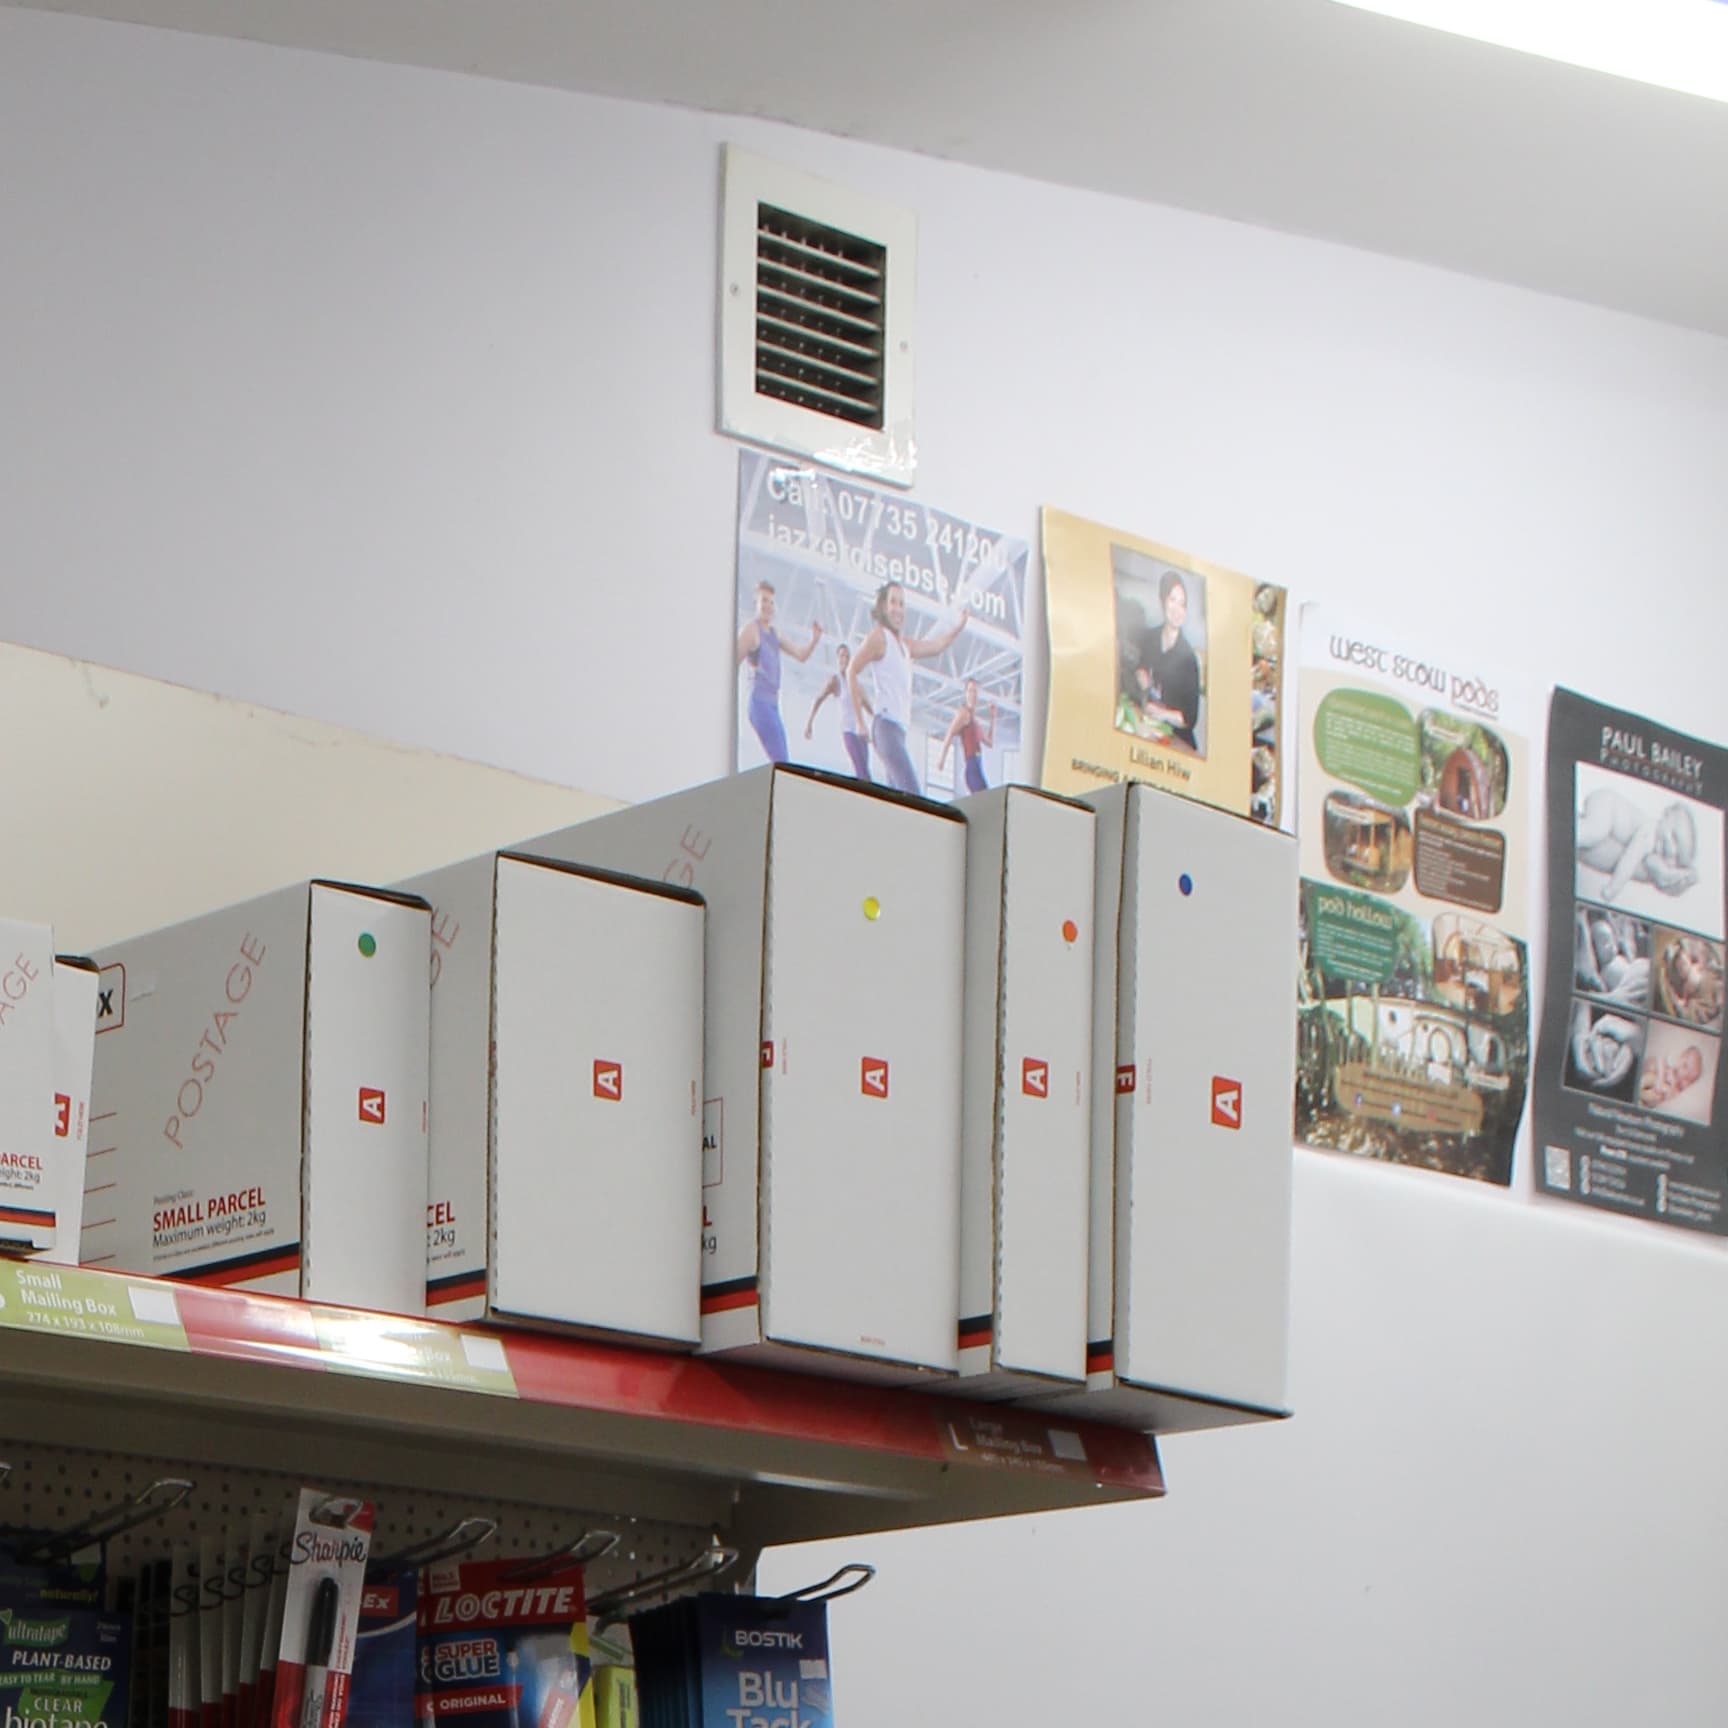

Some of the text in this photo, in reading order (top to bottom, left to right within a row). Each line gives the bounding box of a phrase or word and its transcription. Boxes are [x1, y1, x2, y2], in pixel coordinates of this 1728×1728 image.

[839, 491, 918, 541] 07735
[1129, 746, 1167, 774] Lilian
[1601, 726, 1646, 758] PAUL
[1651, 742, 1703, 779] BAILEY
[164, 931, 267, 1151] POSTAGE
[152, 1187, 266, 1232] SMALL PARCEL
[15, 1269, 63, 1293] Small
[20, 1287, 118, 1319] Mailing Box
[289, 1530, 367, 1568] Sharpie
[434, 1586, 574, 1625] LOCTITE
[435, 1639, 497, 1661] SUPER
[735, 1630, 803, 1649] BOSTIK
[12, 1650, 112, 1671] PLANT-BASED
[434, 1654, 500, 1682] GLUE
[440, 1692, 506, 1710] ORIGINAL
[739, 1670, 799, 1708] Blu
[34, 1697, 83, 1713] CLEAR
